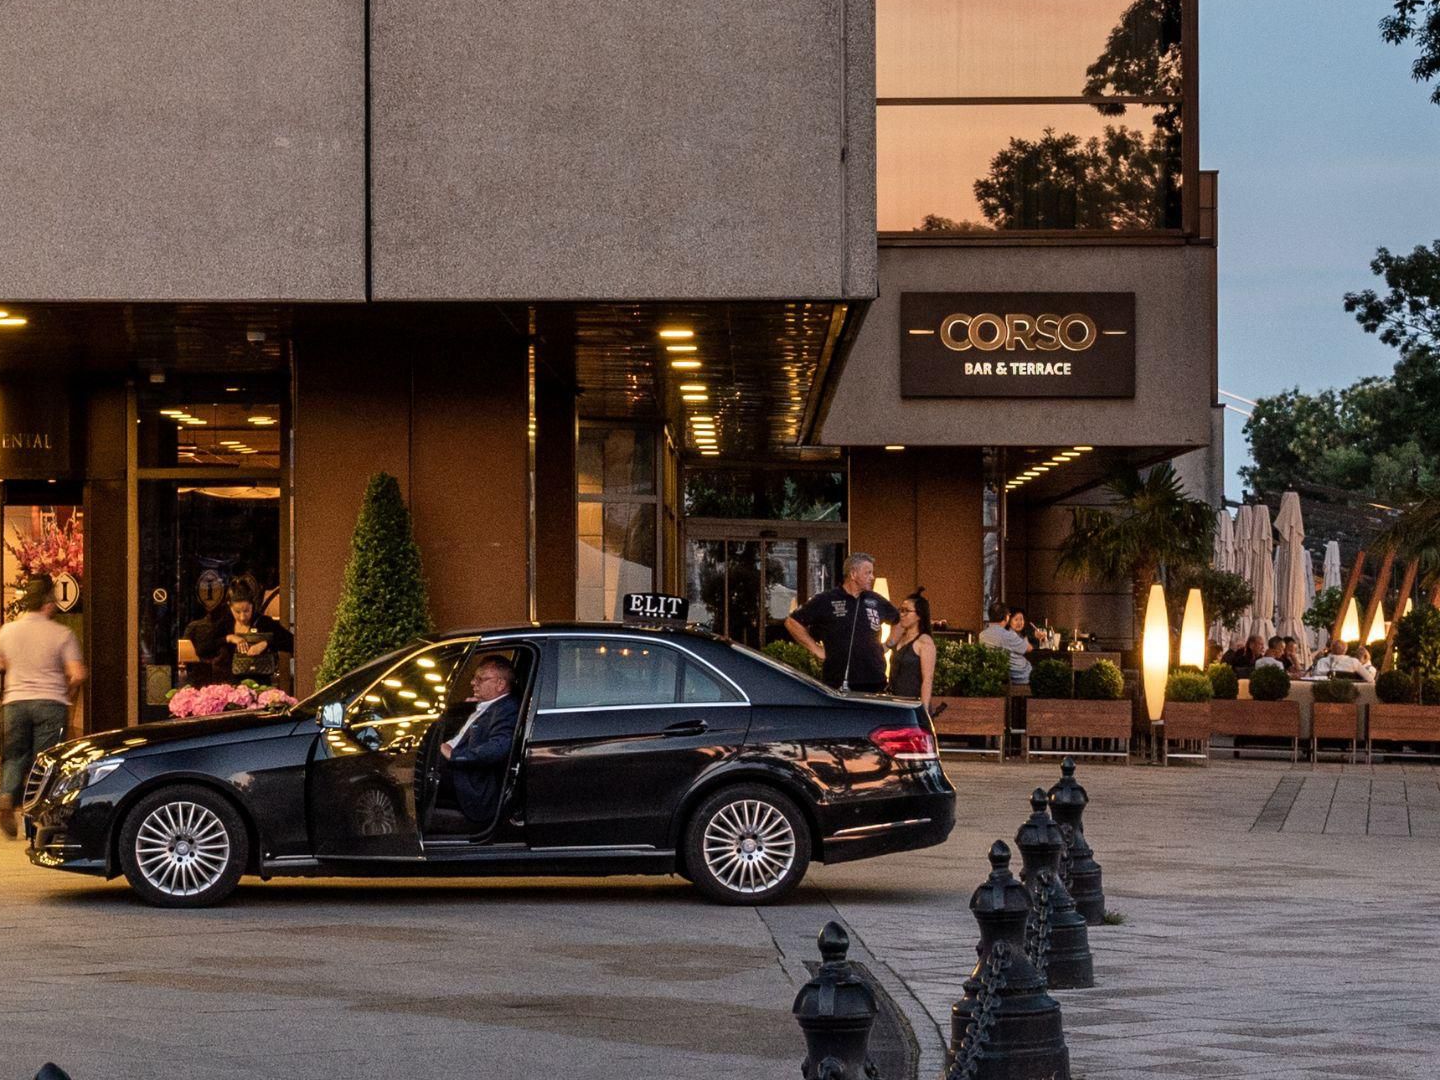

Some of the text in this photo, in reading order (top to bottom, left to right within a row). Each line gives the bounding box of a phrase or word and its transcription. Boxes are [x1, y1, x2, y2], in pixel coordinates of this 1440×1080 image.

[940, 313, 1097, 351] CORSO
[965, 362, 1072, 375] BAR & TERRACE
[630, 594, 682, 614] ELIT
